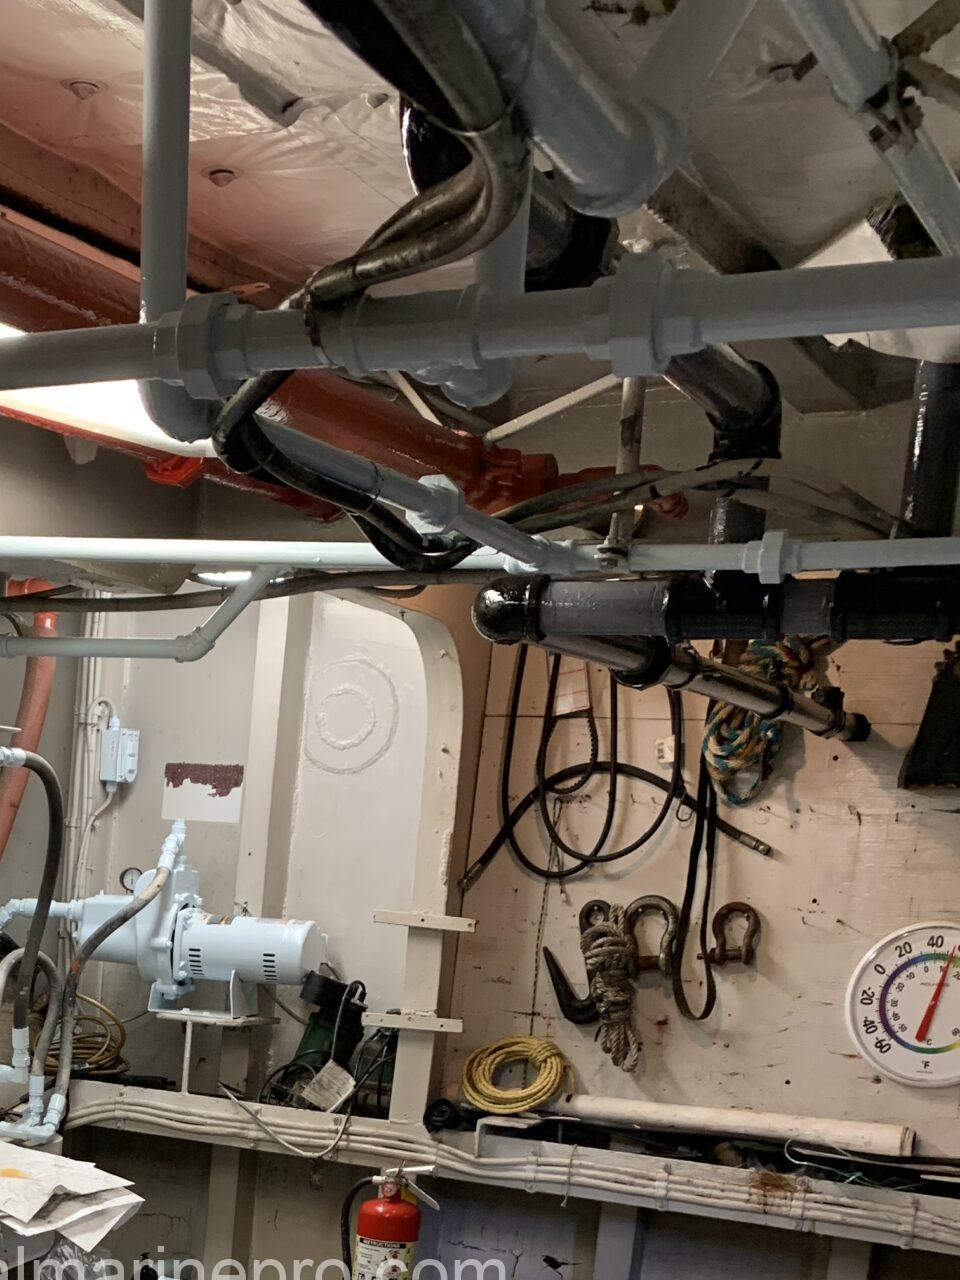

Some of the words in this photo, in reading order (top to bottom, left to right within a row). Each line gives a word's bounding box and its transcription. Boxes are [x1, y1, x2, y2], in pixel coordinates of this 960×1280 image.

[895, 941, 912, 958] 20
[927, 935, 944, 948] 40
[874, 963, 886, 976] 0
[860, 987, 875, 1006] -20
[862, 1016, 878, 1034] -40
[875, 1036, 892, 1054] -60
